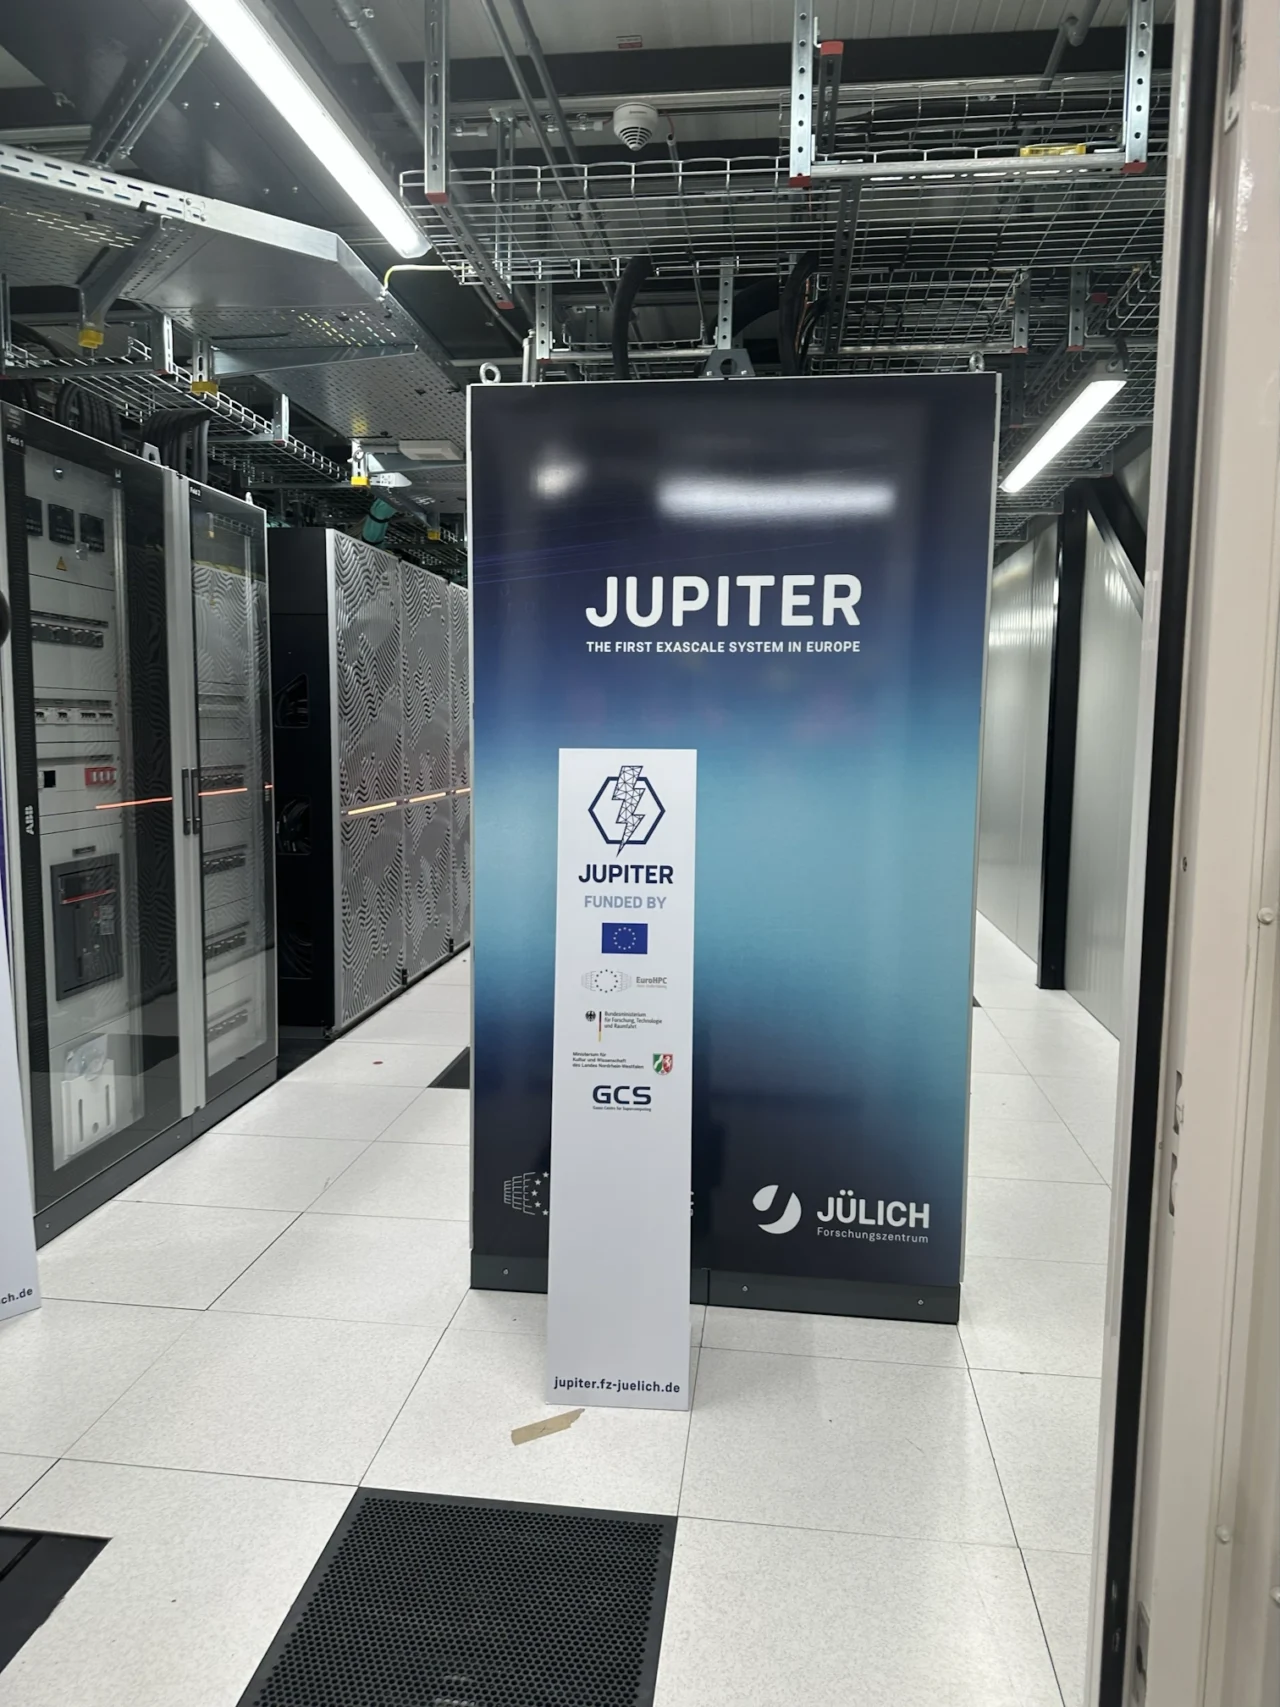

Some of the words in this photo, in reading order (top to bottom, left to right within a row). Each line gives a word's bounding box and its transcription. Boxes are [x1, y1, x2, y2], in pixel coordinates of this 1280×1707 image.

[585, 574, 862, 627] JUPITER
[586, 641, 611, 653] THE
[615, 641, 652, 653] FIRST
[656, 641, 725, 653] EXASCALE
[729, 641, 784, 653] SYSTEM
[788, 641, 802, 653] IN
[806, 641, 861, 653] EUROPE
[25, 804, 35, 836] ABB
[578, 864, 674, 884] JUPITER
[584, 895, 643, 909] FUNDED
[647, 896, 667, 909] BY
[636, 976, 668, 984] EuroHPC
[592, 1084, 652, 1105] GCS
[816, 1189, 930, 1229] JÜLICH
[816, 1227, 929, 1243] Forschungszentrum
[553, 1376, 680, 1393] jupiter.fz-juelich.de
